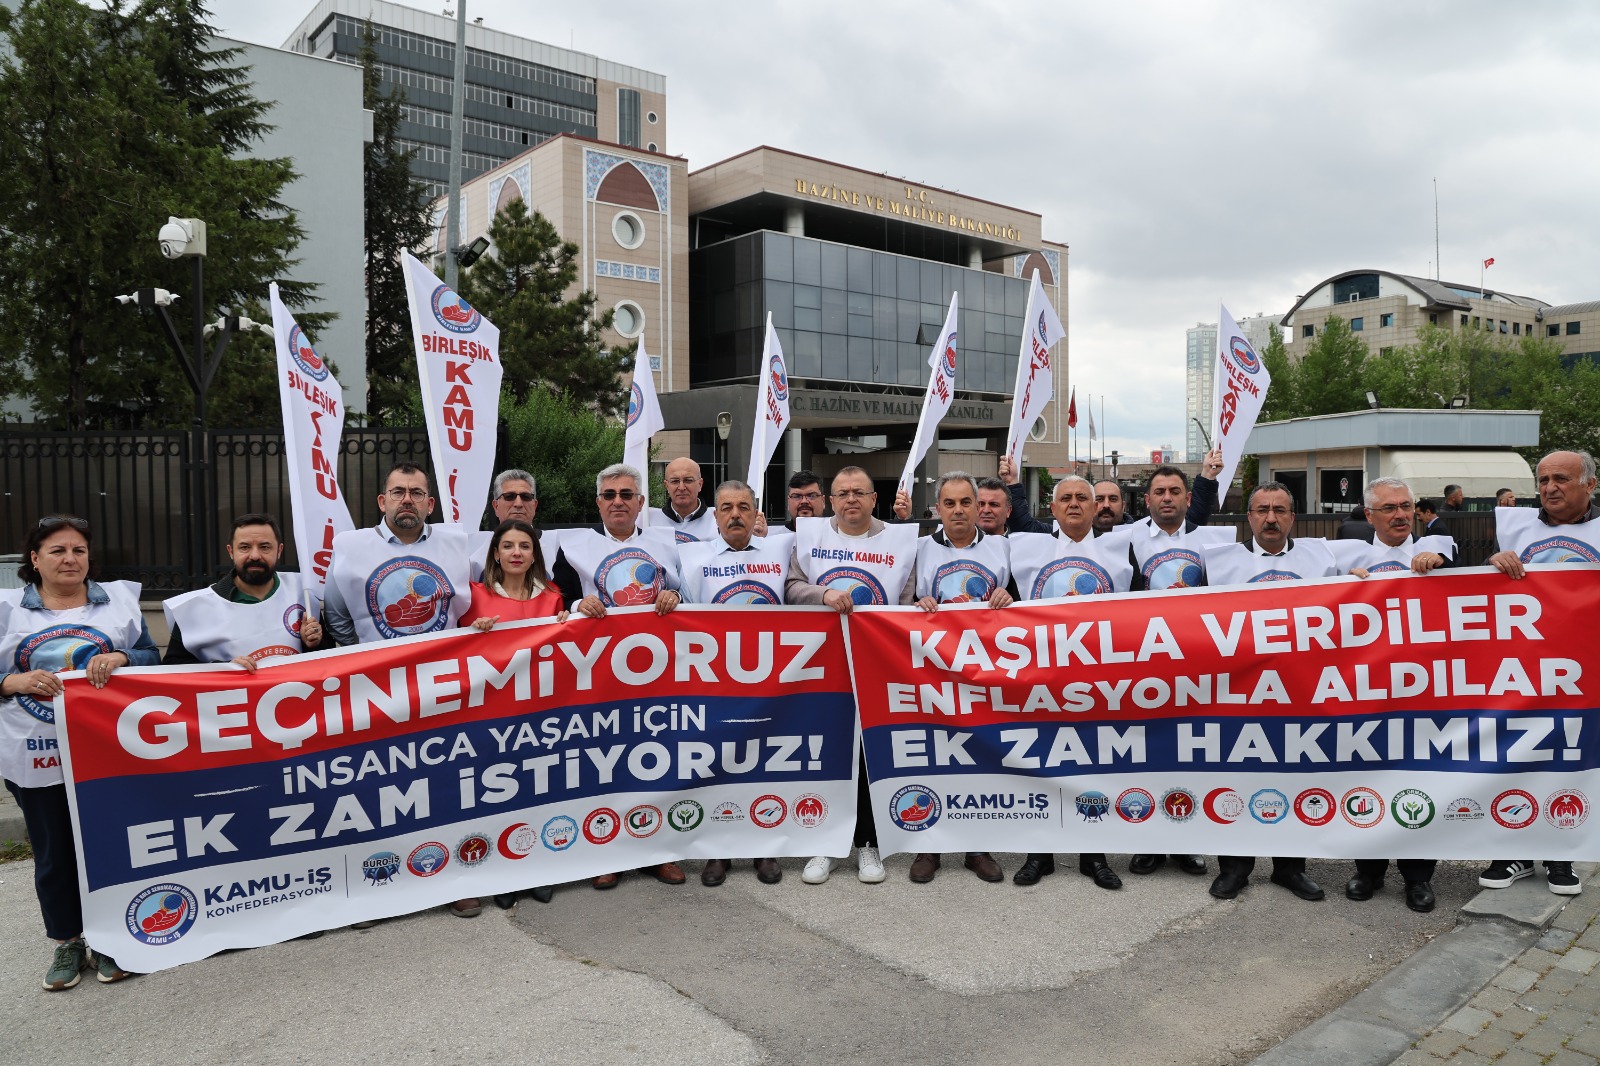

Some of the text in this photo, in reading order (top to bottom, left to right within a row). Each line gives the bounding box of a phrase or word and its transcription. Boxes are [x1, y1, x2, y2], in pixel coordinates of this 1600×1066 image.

[796, 179, 1022, 241] HAZİNE VE MALİYE BAKANLIĞI
[904, 186, 934, 205] T.C.
[421, 330, 494, 364] BİRLEŞİK
[443, 360, 475, 452] KAMU
[788, 395, 994, 420] .C. HAZİNE VE MALİY KANLIĞI
[703, 561, 782, 579] BİRLEŞİK KAMU-İŞ
[811, 546, 895, 568] BİRLEŞİK KAMU-İŞ
[909, 593, 1545, 680] KAŞIKLA VERDİLER
[116, 631, 828, 760] GEÇİNEMİYORUZ
[886, 657, 1584, 716] ENFLASYONLA ALDILAR
[20, 695, 54, 719] BİRLEŞ
[26, 735, 59, 751] BİR
[283, 703, 706, 796] İNSANCA YAŞAM İÇİN
[890, 716, 1583, 769] EK ZAM HAKKIMIZ!
[33, 757, 63, 769] KA
[126, 812, 239, 869] EK
[268, 777, 431, 847] ZAM
[459, 734, 824, 810] İSTİYORUZ!
[946, 793, 1049, 811] KAMU-İŞ
[947, 811, 1049, 820] KONFEDERASYONU
[203, 866, 332, 907] KAMU-İŞ
[206, 884, 333, 919] KONFEDERASYONU
